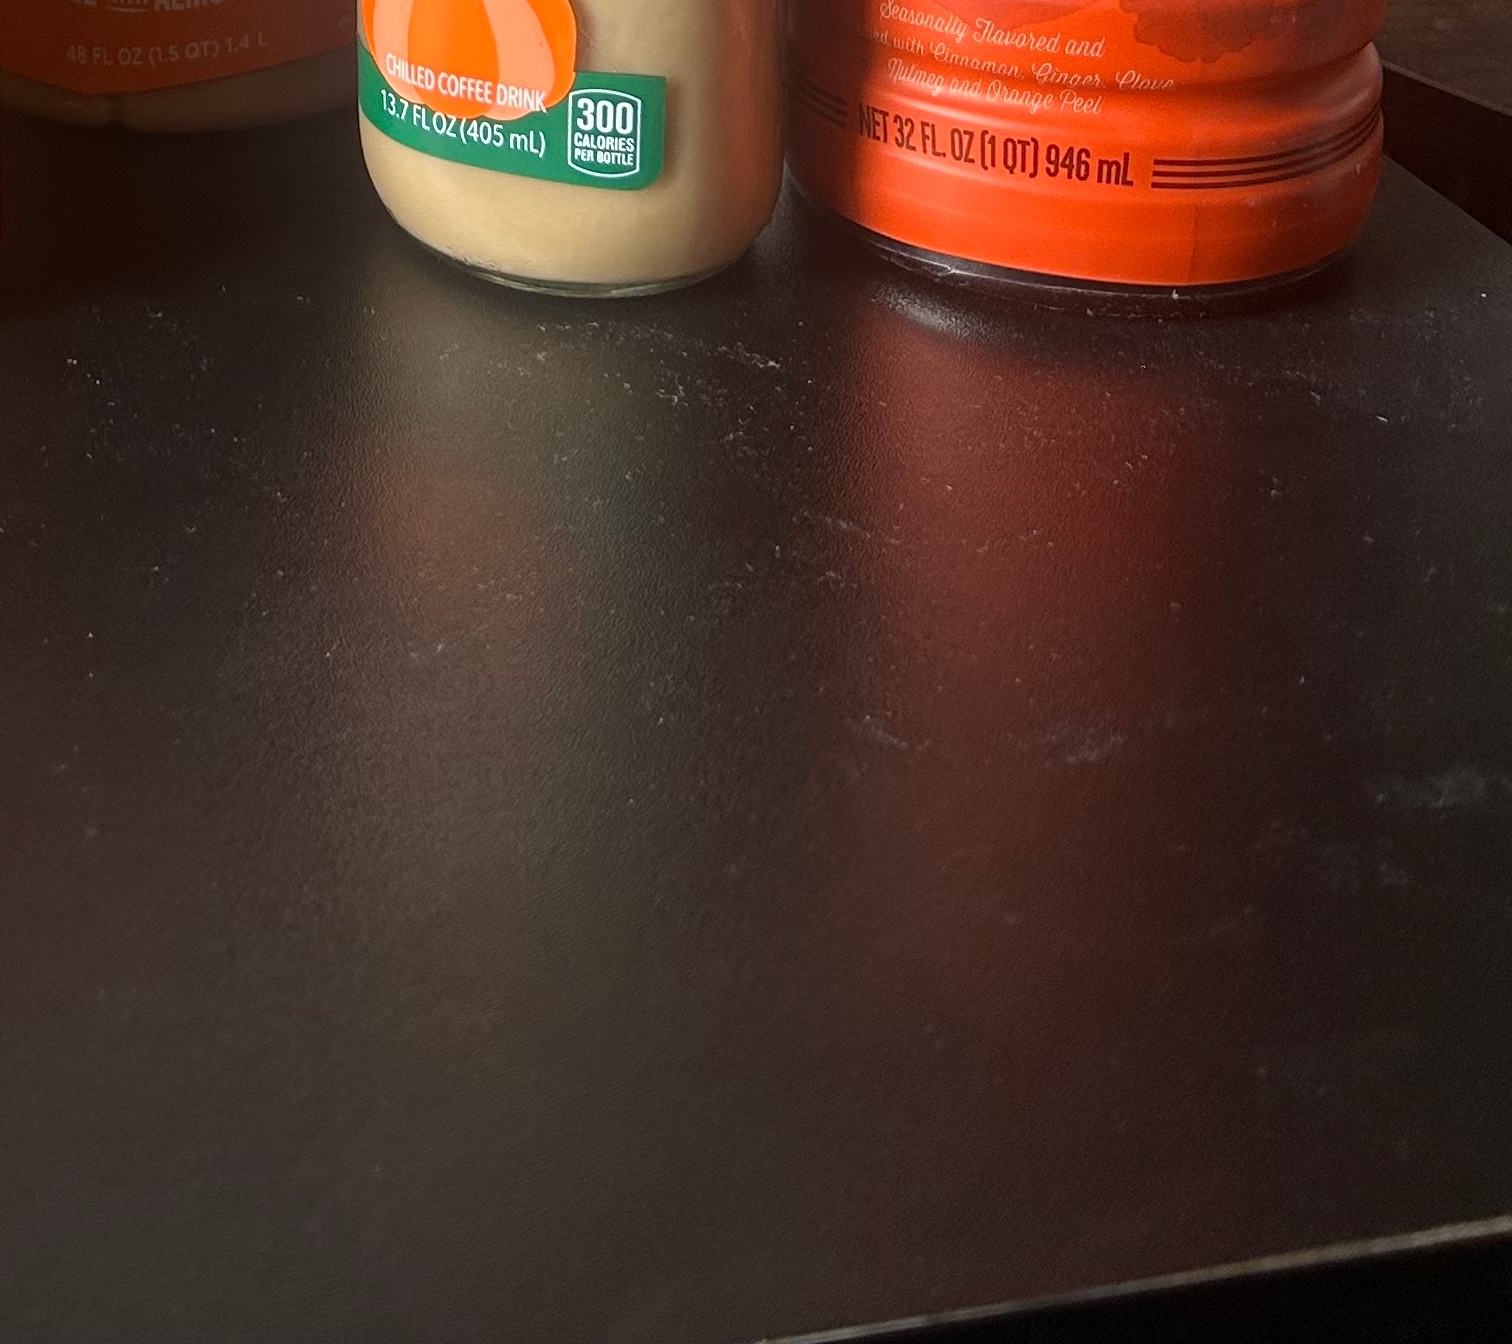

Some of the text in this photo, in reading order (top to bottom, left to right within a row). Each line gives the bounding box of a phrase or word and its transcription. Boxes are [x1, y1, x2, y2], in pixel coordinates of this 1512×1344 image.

[92, 48, 114, 66] FL
[118, 47, 143, 66] OZ
[893, 37, 925, 56] with
[972, 17, 1062, 55] Flavored
[1064, 36, 1106, 59] and
[385, 52, 548, 114] CHILLED COFFEE DRINK
[888, 56, 1102, 115] Nutmeg and Orange Peel
[380, 88, 547, 159] 13.7 FL OZ (405 mL)
[575, 97, 634, 135] 300
[573, 131, 636, 153] CALORIES
[574, 147, 635, 167] PER BOTTLE
[857, 102, 890, 143] NET
[892, 115, 917, 153] 32
[920, 120, 946, 158] FL.
[950, 127, 976, 165] OZ
[1001, 137, 1040, 179] QT)
[1044, 142, 1092, 181] 946
[1096, 152, 1135, 187] mL
